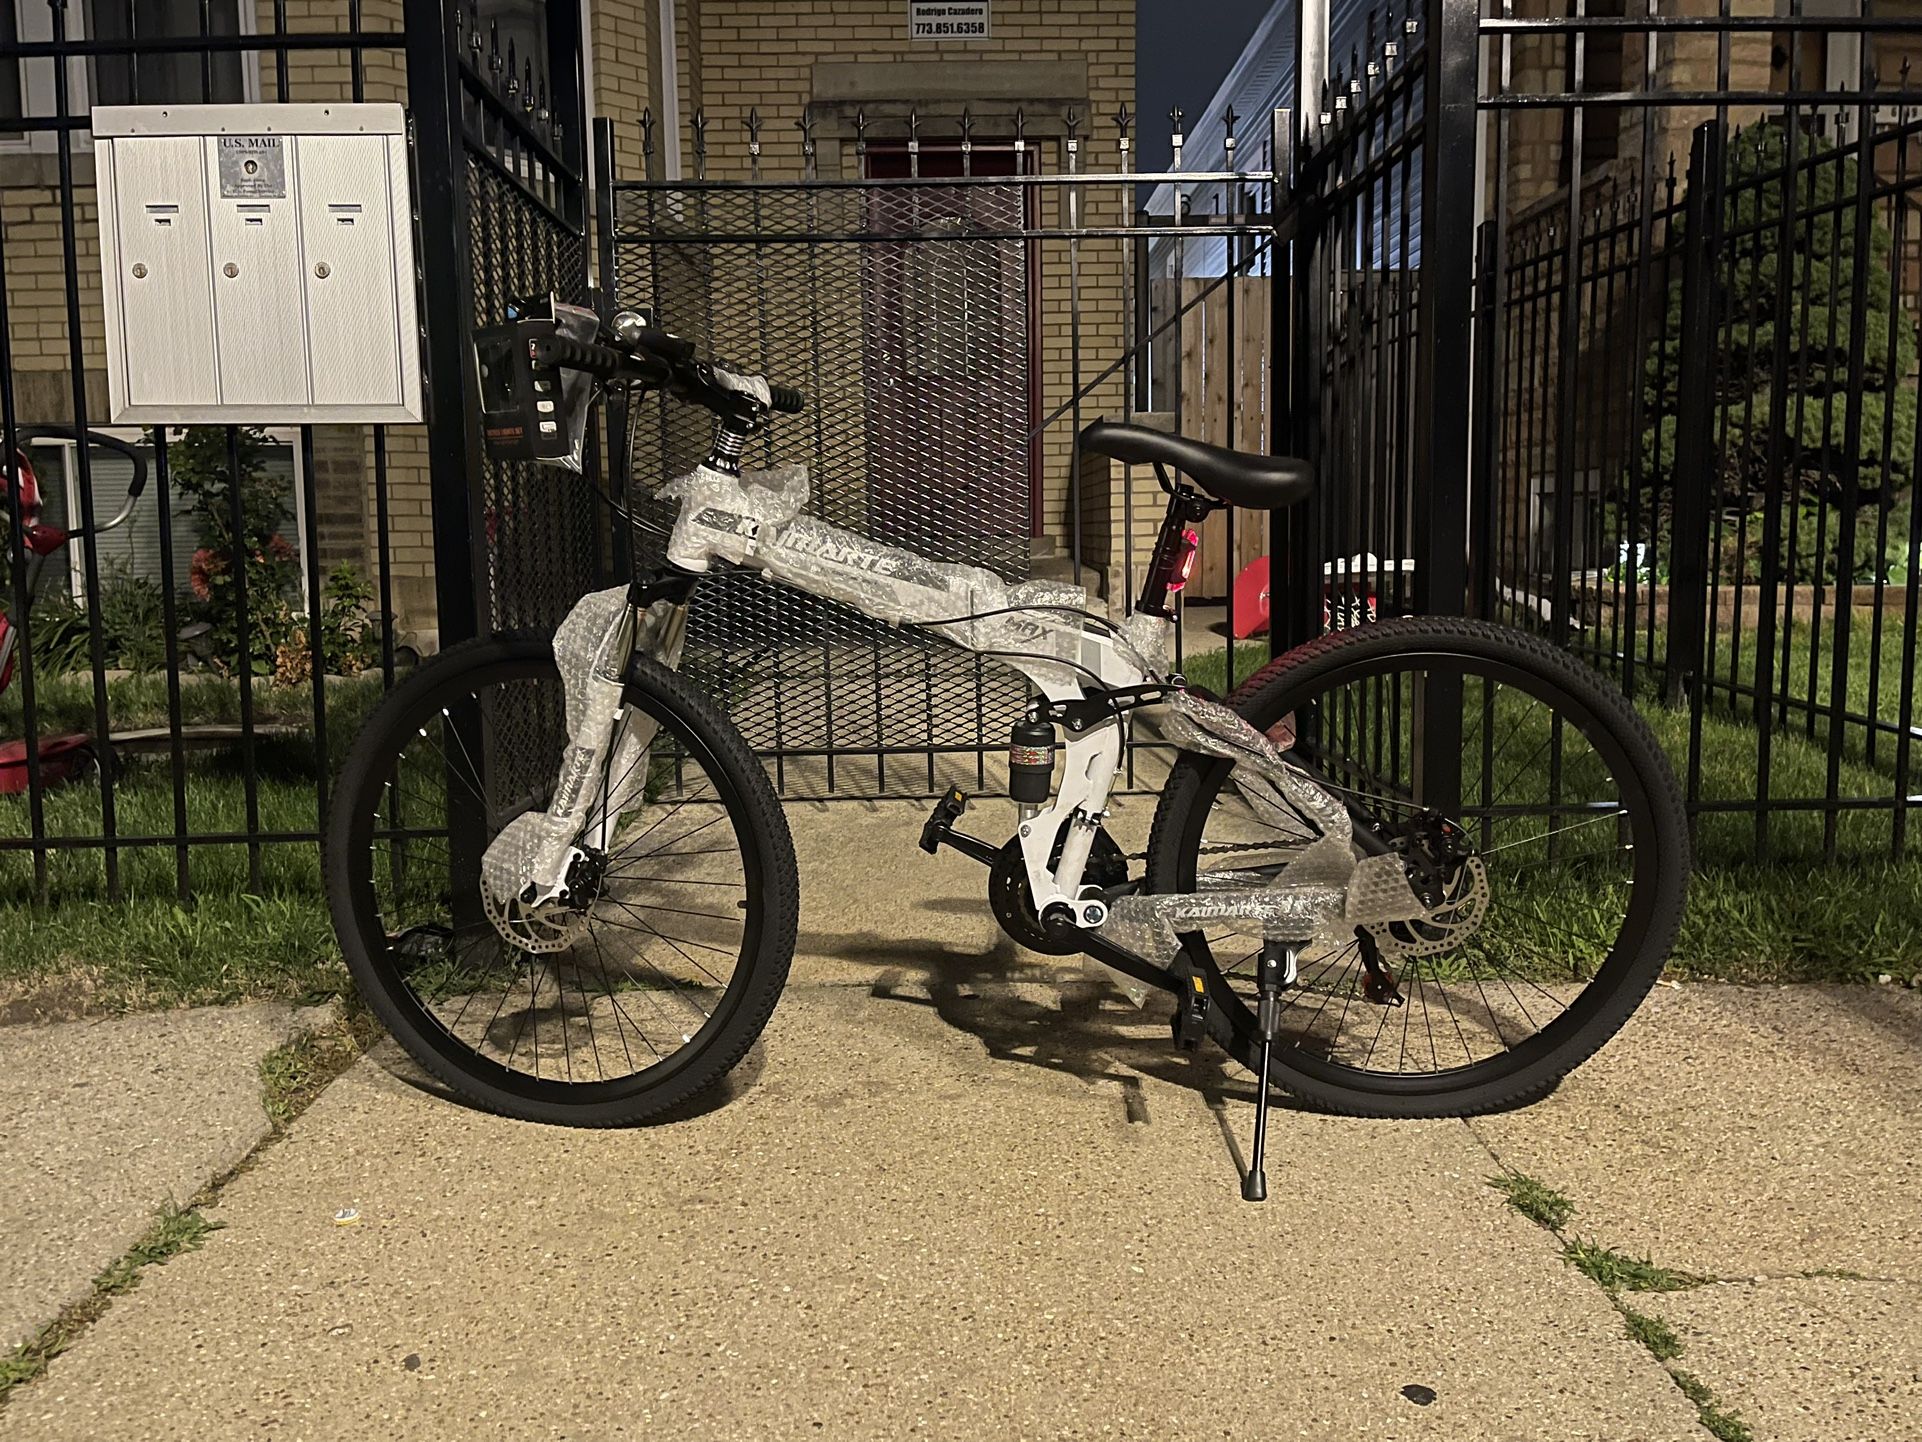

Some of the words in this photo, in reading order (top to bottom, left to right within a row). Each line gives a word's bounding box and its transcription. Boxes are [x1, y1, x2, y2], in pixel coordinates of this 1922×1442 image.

[916, 7, 946, 16] Rodrigo
[915, 22, 985, 34] 773.851.6358
[223, 138, 245, 148] U.S.
[248, 138, 280, 148] MAIL
